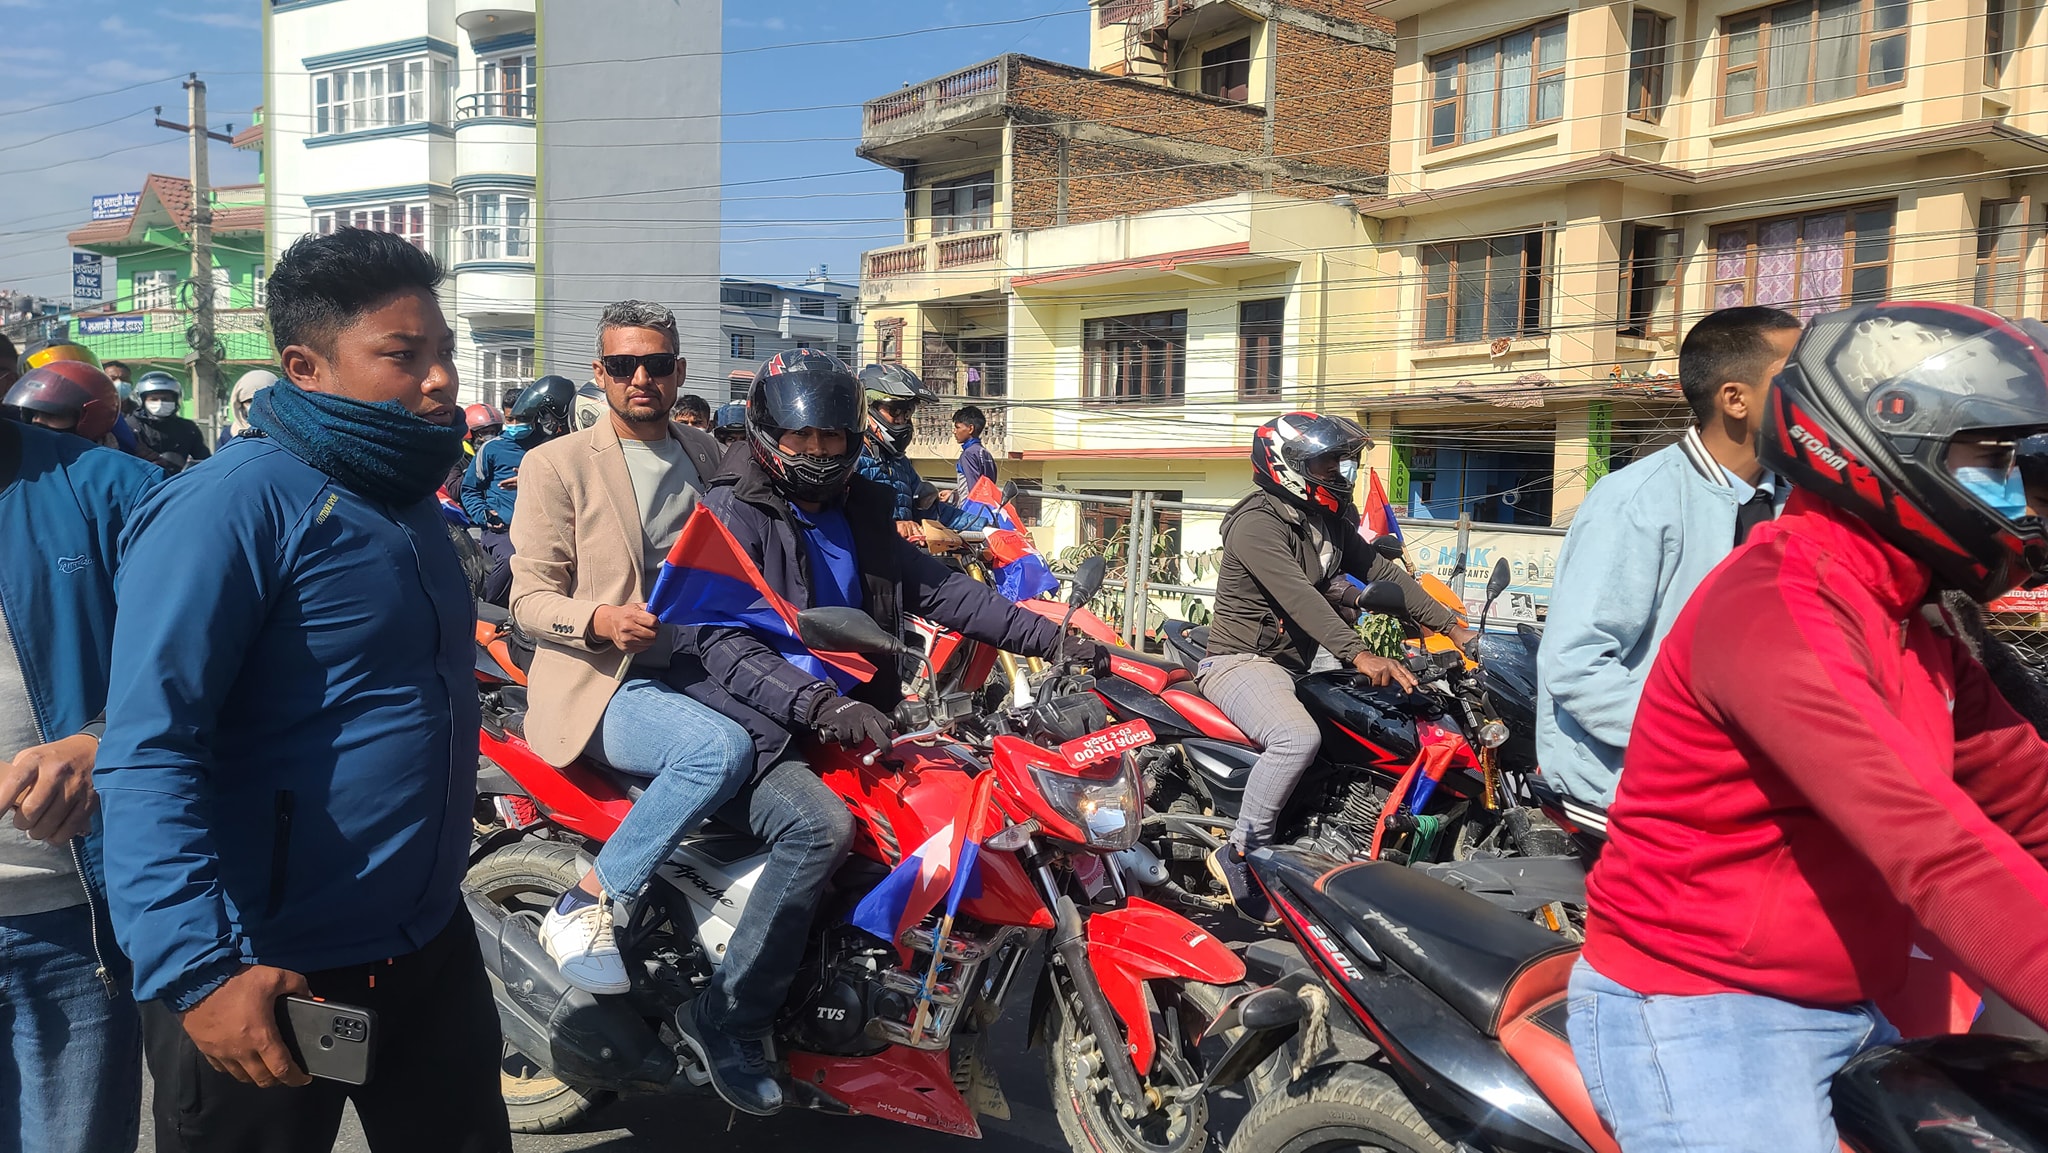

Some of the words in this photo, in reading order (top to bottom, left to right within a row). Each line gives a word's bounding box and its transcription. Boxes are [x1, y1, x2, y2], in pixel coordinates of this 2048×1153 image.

[1789, 425, 1849, 471] STORM
[1437, 567, 1489, 579] LUBCANTS
[662, 860, 738, 909] Apache
[1306, 924, 1364, 980] 220F
[817, 1006, 846, 1021] TVS
